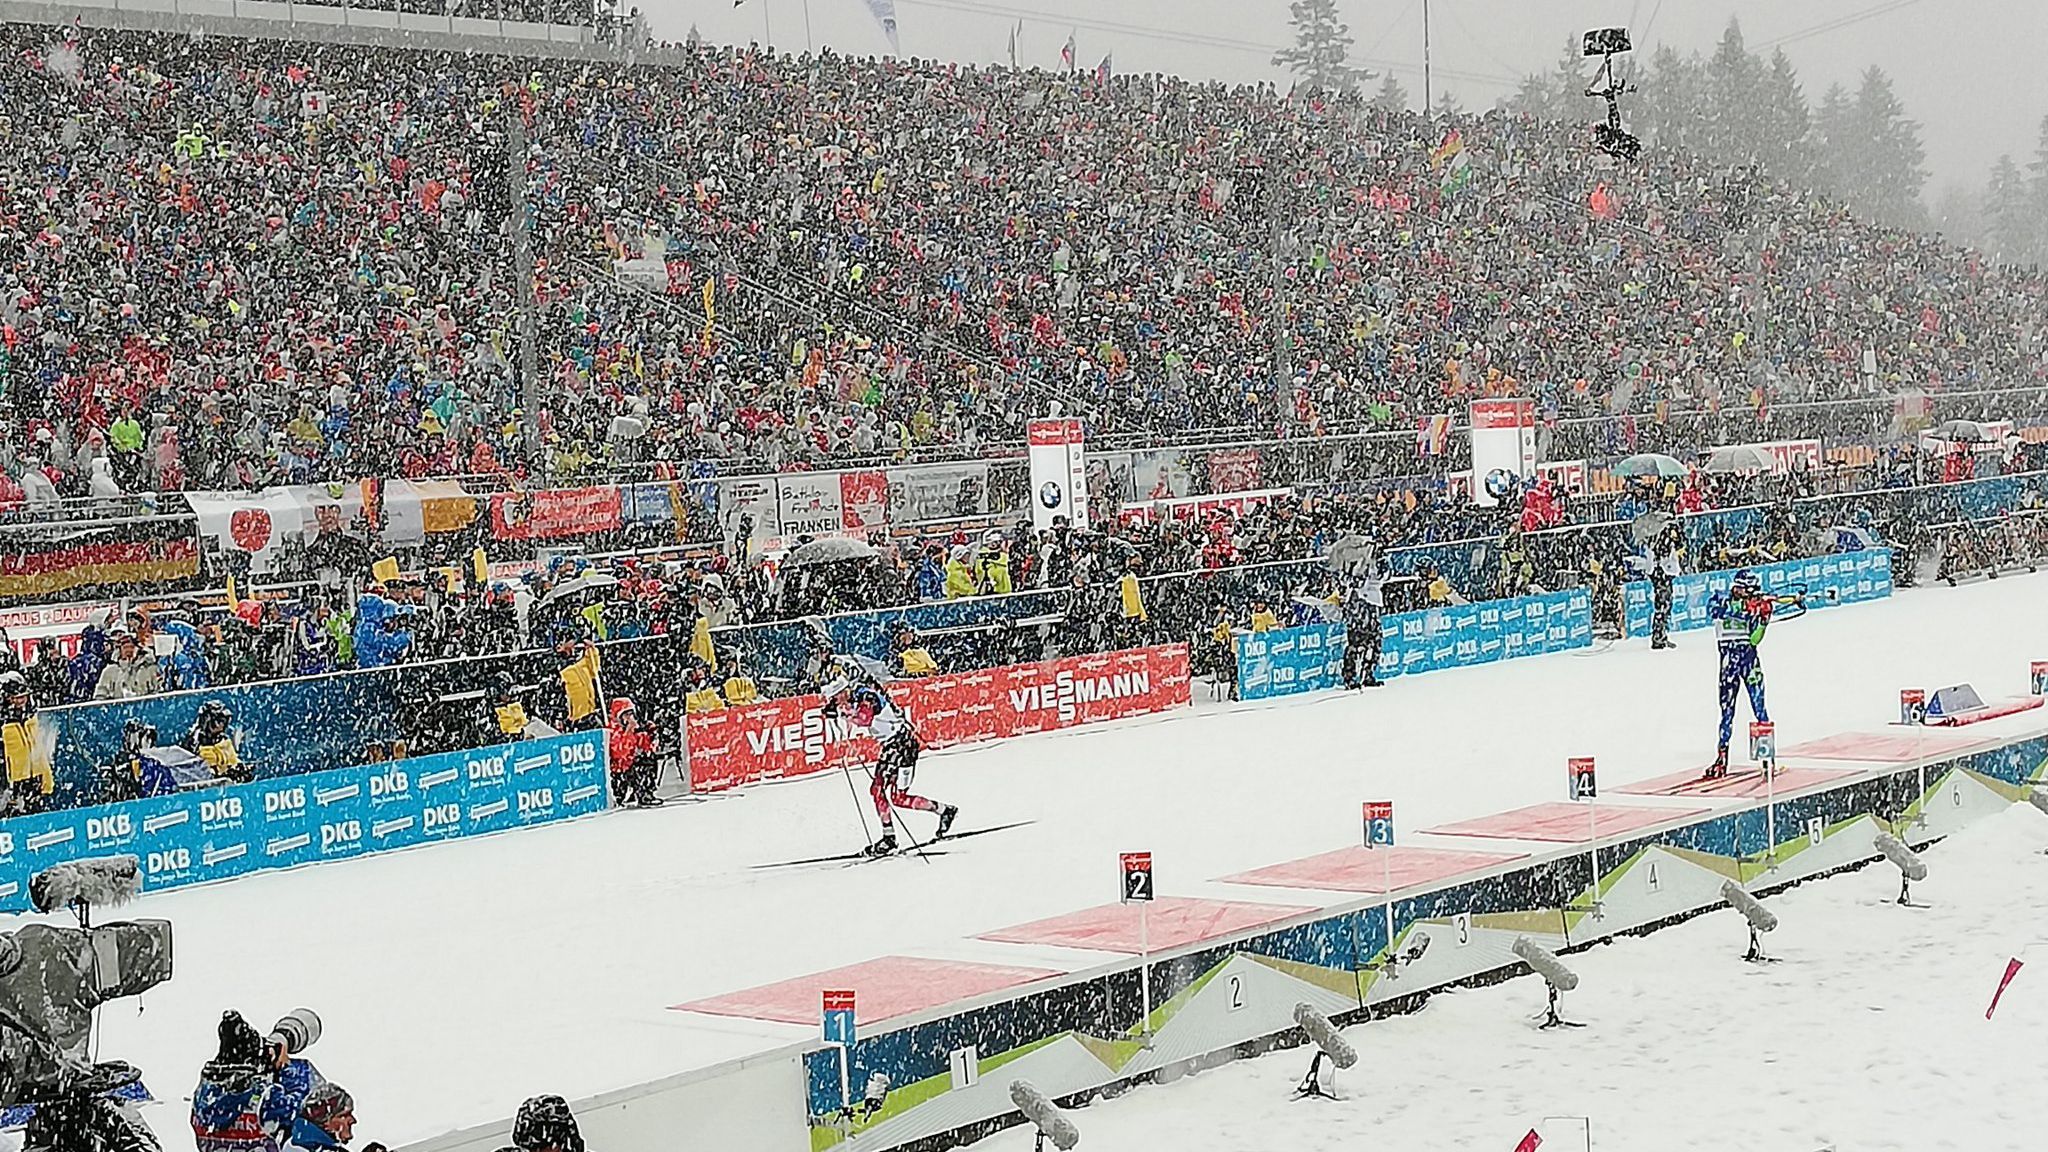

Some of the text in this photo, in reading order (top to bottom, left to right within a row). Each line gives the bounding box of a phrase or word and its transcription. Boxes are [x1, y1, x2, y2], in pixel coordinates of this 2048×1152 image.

[784, 518, 839, 535] FRANKEN
[1008, 669, 1150, 722] VIESSMANN
[1910, 703, 1920, 722] 6
[560, 743, 595, 765] DKB
[1758, 736, 1769, 757] 5
[468, 757, 504, 780] DKB
[370, 772, 409, 796] DKB
[1579, 772, 1593, 796] 4
[1953, 784, 1960, 806] 6
[200, 796, 243, 822] DKB
[265, 788, 306, 813] DKB
[517, 788, 553, 811] DKB
[86, 814, 131, 840] DKB
[423, 803, 461, 827] DKB
[320, 820, 362, 846] DKB
[1374, 819, 1387, 843] 3
[1813, 820, 1820, 844] 5
[148, 848, 191, 874] DKB
[1130, 871, 1147, 898] 2
[1649, 863, 1658, 889] 4
[1458, 916, 1468, 944] 3
[1230, 977, 1242, 1008] 2
[834, 1012, 846, 1041] 1
[960, 1051, 969, 1085] 1
